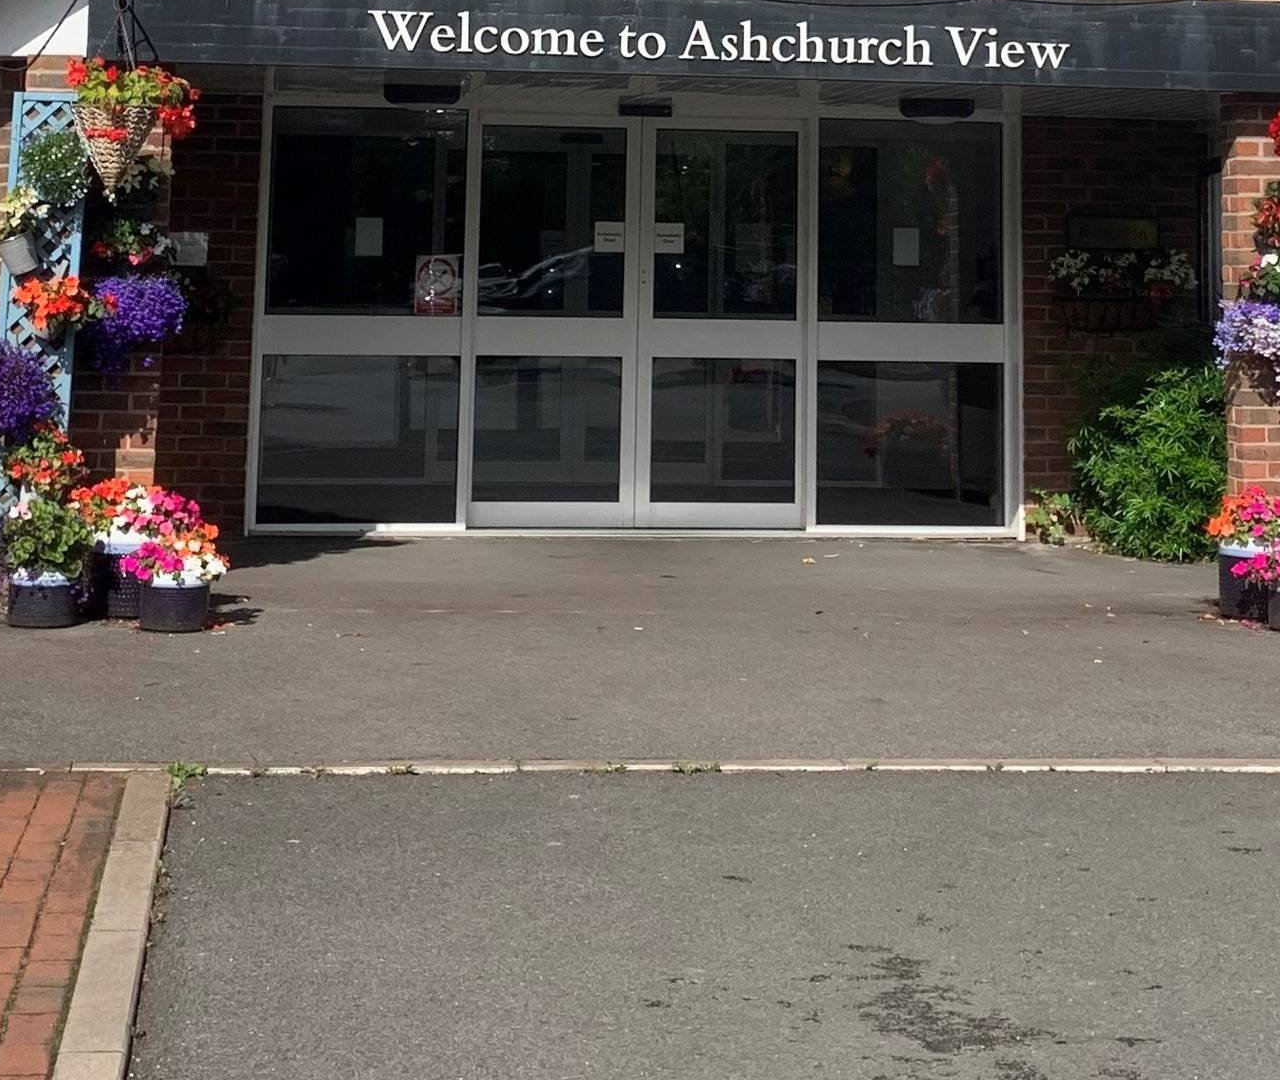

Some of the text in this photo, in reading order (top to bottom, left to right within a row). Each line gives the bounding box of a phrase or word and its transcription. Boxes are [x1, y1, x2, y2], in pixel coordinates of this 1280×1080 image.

[367, 9, 1071, 69] Welcome to Ashchurch View
